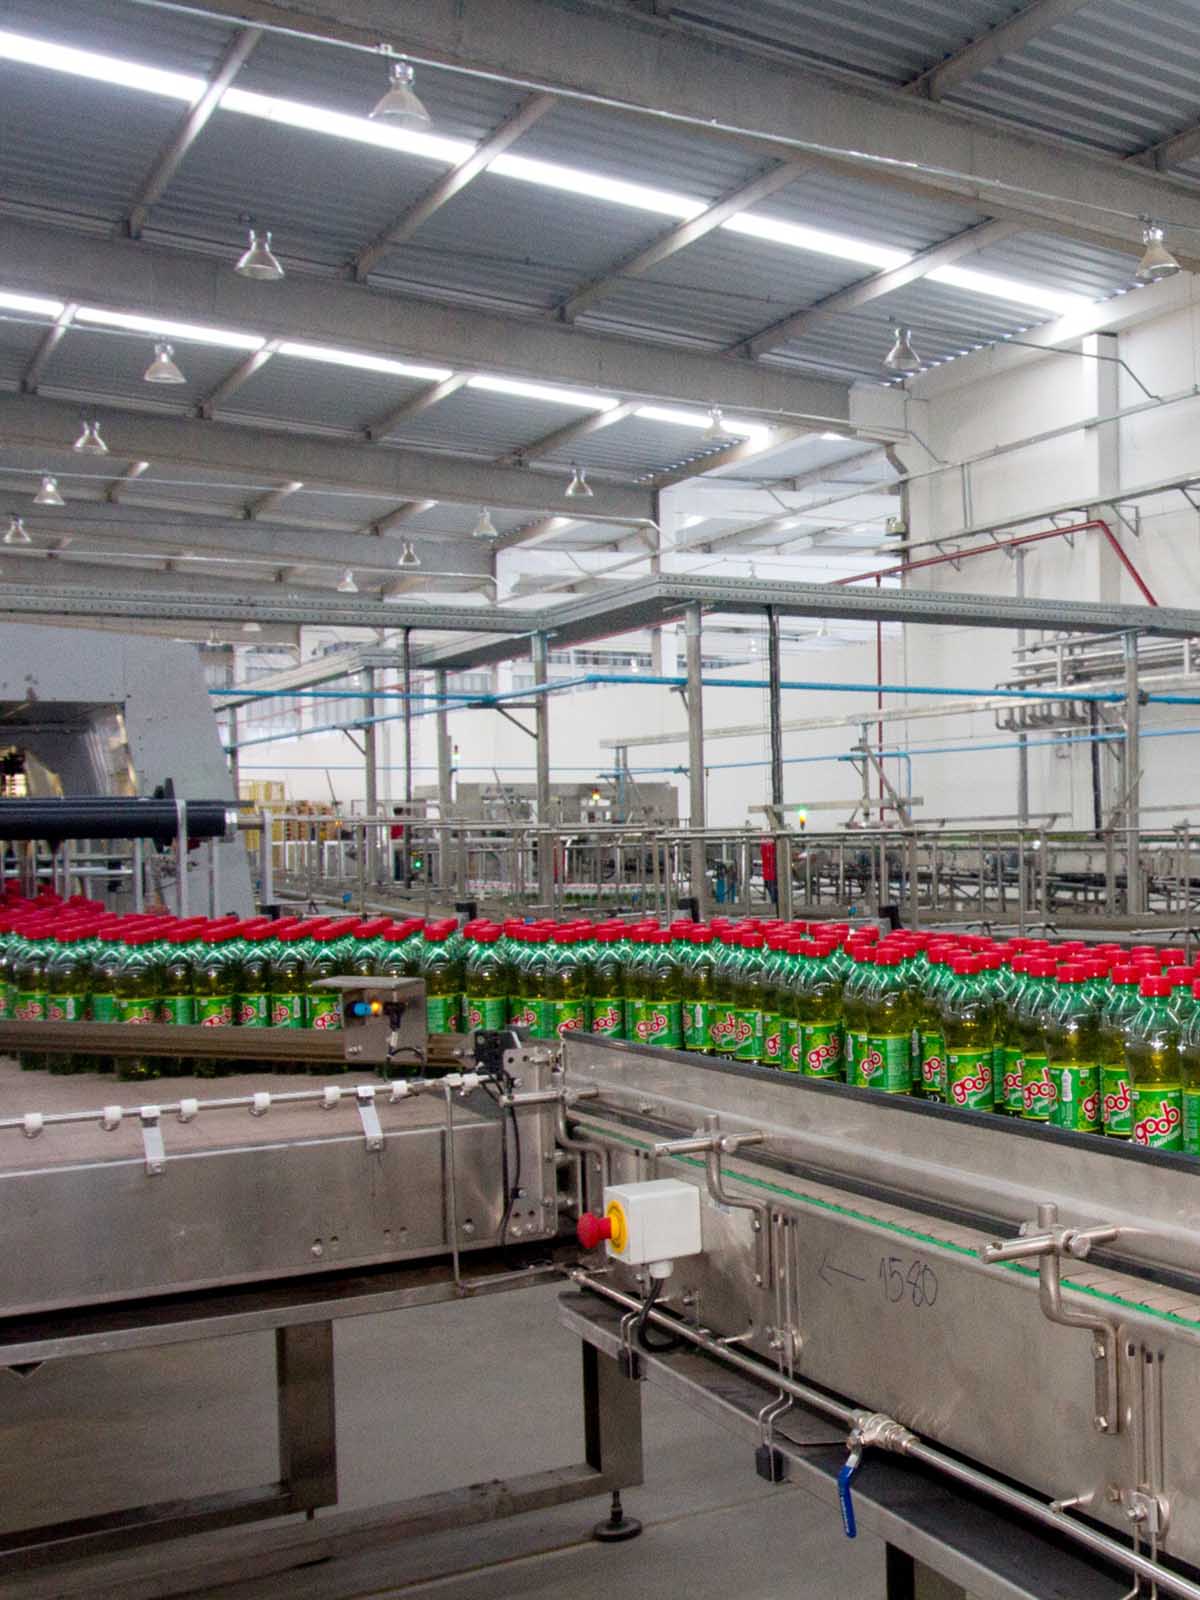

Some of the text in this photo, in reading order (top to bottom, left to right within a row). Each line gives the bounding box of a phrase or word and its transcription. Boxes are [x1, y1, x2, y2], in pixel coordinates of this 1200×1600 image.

[951, 1062, 992, 1104] goob
[1134, 1100, 1181, 1146] goob
[880, 1256, 938, 1308] 1580
